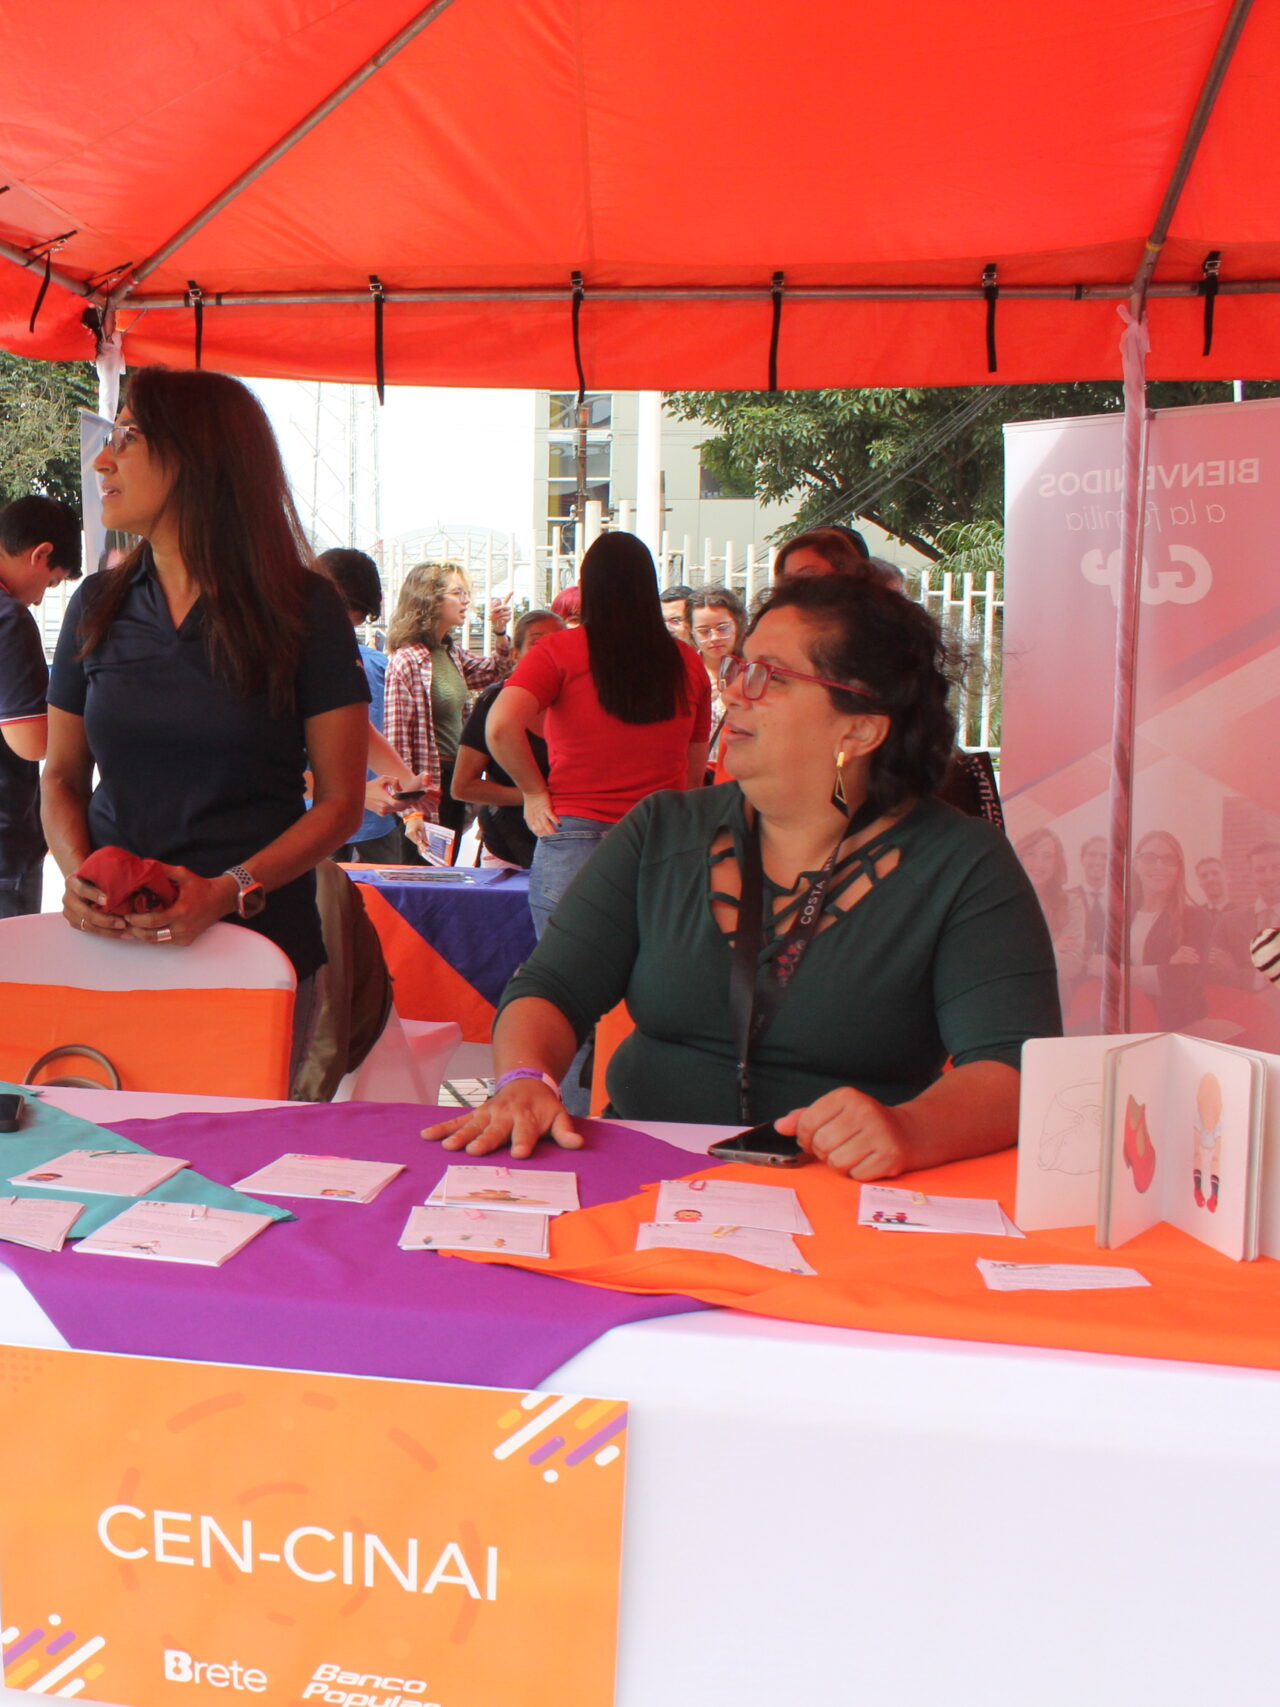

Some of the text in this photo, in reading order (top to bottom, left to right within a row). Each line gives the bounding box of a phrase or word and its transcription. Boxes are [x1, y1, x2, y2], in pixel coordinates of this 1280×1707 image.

[800, 881, 825, 925] COSTA
[97, 1504, 498, 1601] CEN-CINAI
[164, 1649, 268, 1692] Brete
[312, 1664, 427, 1693] Banco
